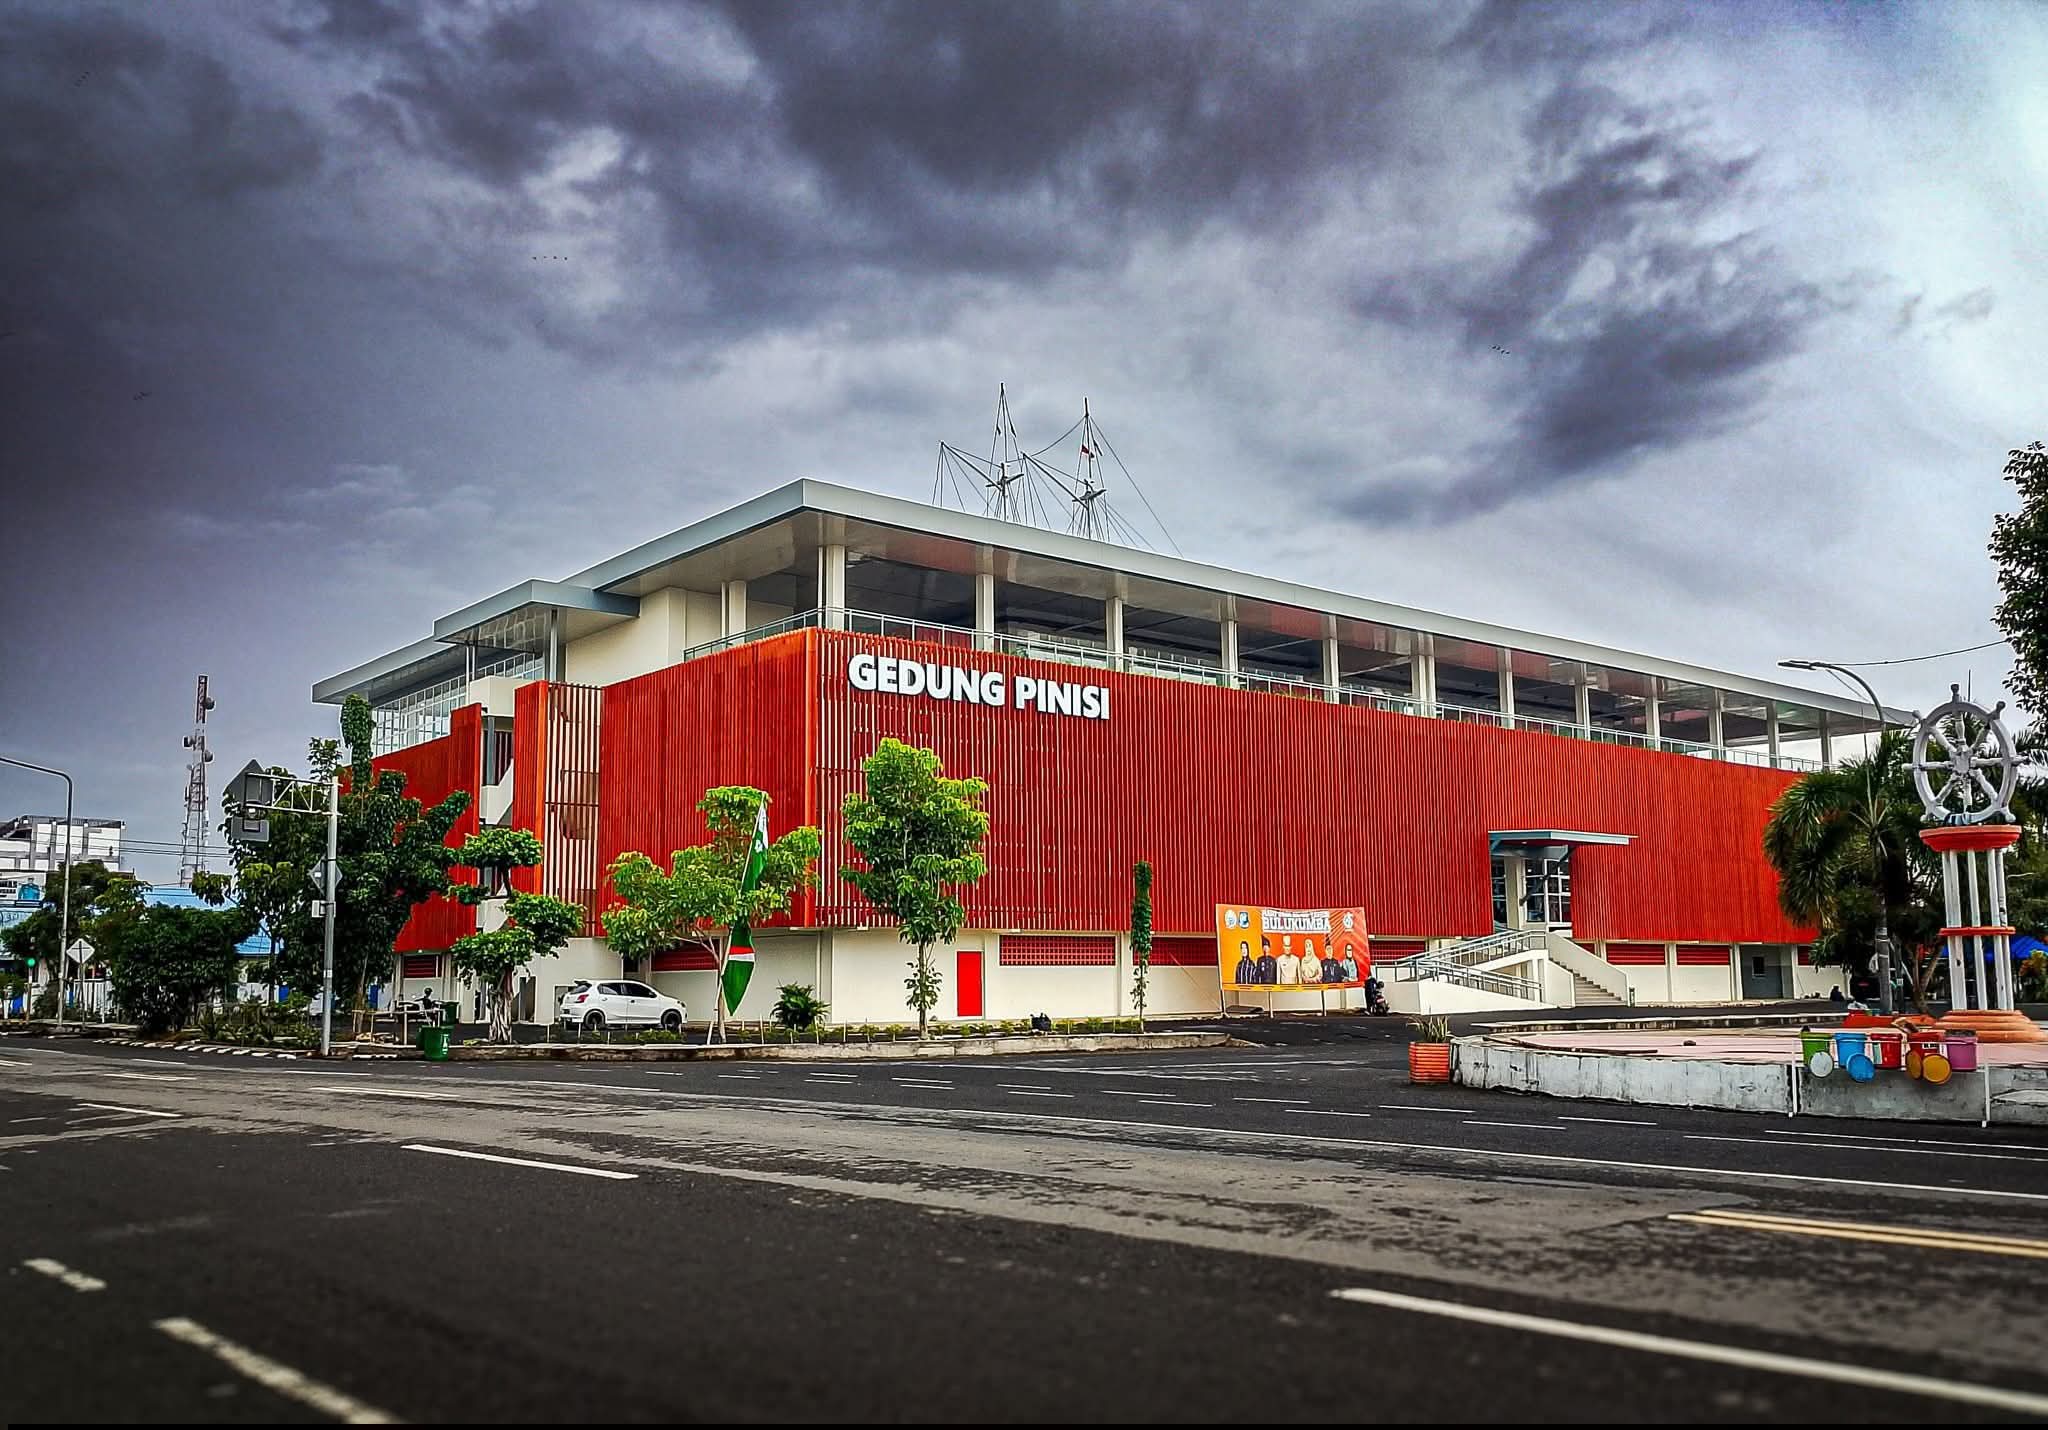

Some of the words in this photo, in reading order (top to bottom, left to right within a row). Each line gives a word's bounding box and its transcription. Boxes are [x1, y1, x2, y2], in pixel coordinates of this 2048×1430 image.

[848, 654, 1005, 706] GEDUNG
[1015, 675, 1110, 720] PINISI
[1263, 916, 1329, 930] BULUKUMBA
